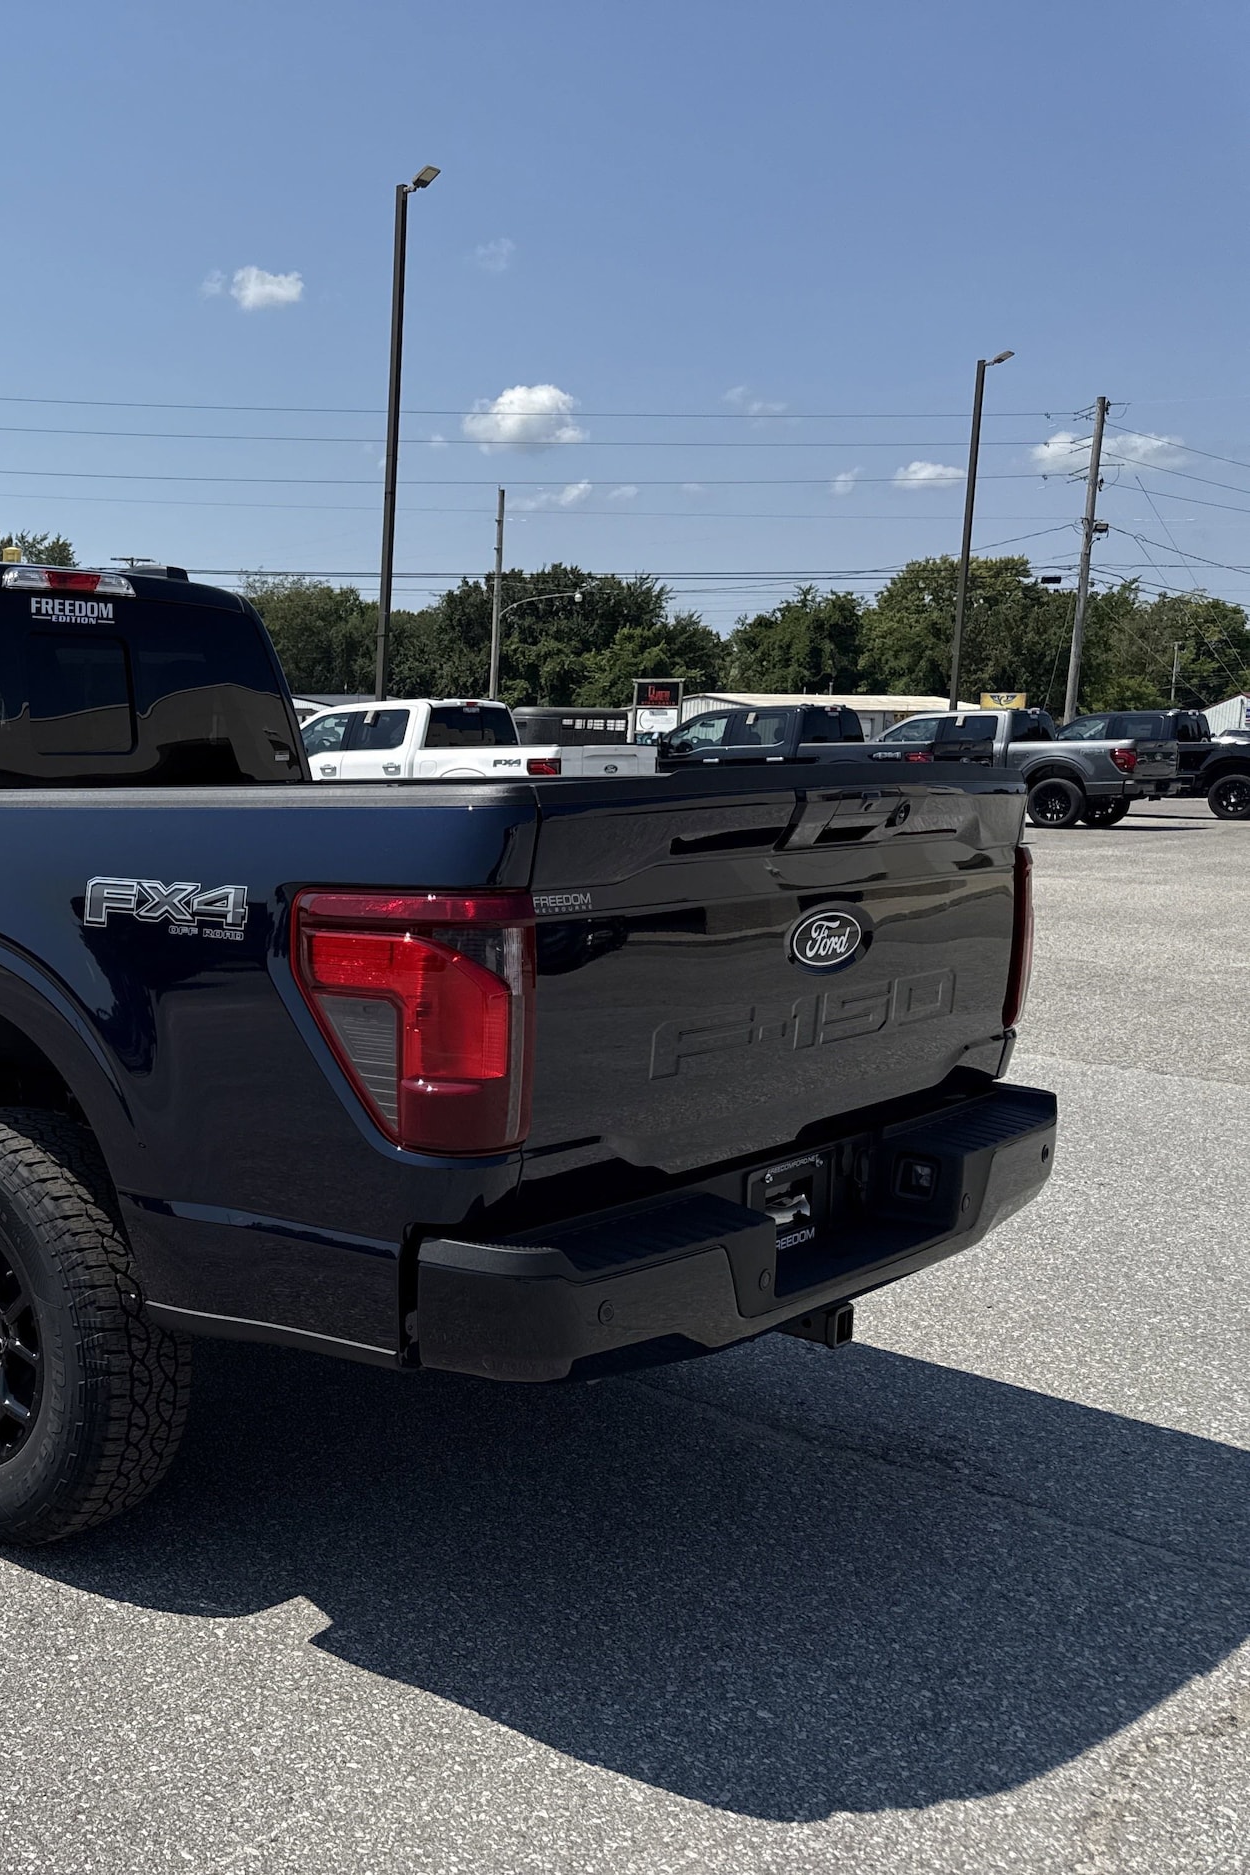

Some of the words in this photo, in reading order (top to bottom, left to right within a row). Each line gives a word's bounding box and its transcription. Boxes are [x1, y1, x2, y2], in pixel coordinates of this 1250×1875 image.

[30, 597, 113, 618] FREEDOM
[52, 615, 97, 624] EDITION
[84, 876, 249, 930] FX4
[533, 892, 592, 908] FREEDOM
[534, 904, 593, 914] MELBOURNE
[168, 925, 199, 936] OFF
[203, 928, 245, 941] ROAD
[806, 920, 850, 958] Ford
[650, 968, 956, 1081] F-150
[775, 1226, 816, 1251] REEDOM
